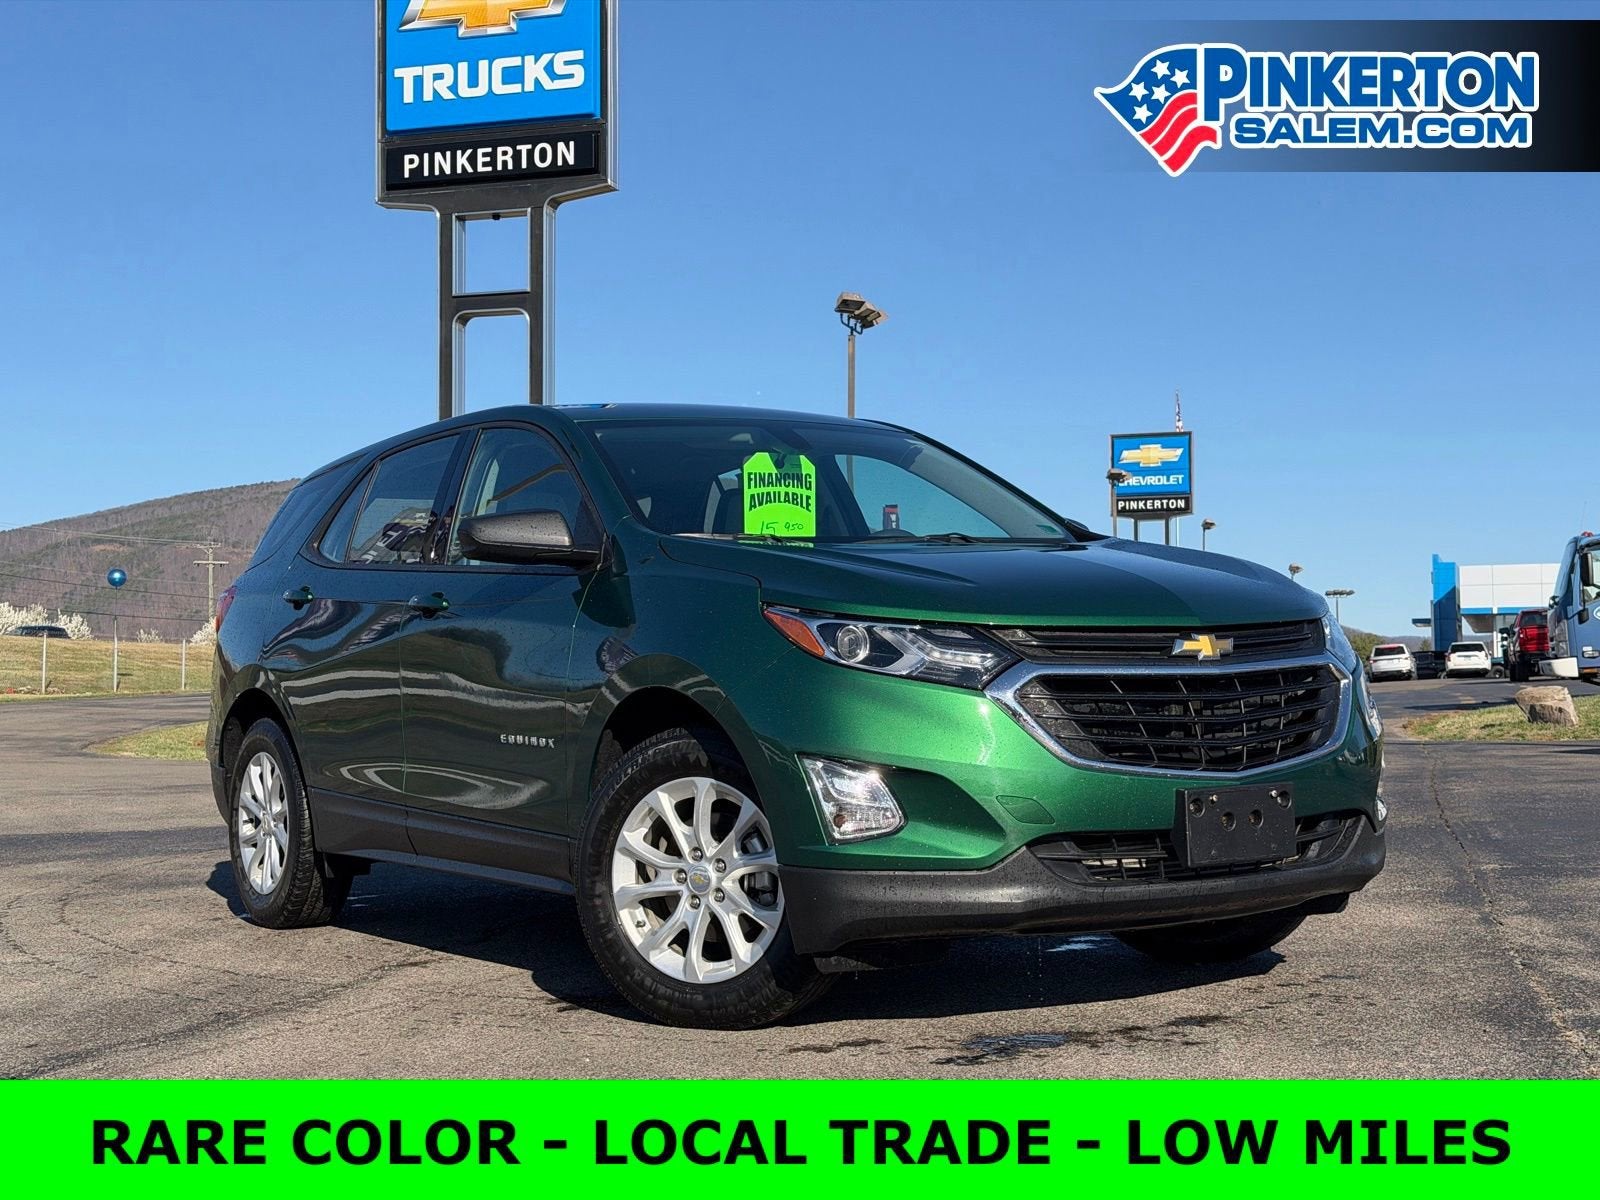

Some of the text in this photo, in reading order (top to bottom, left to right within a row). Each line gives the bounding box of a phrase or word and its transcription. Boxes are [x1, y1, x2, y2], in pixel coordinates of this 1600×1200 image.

[394, 50, 585, 104] TRUCKS
[403, 141, 575, 178] PINKERTON
[747, 472, 812, 491] FINANCING
[748, 491, 812, 512] AVAILABLE
[1118, 500, 1185, 510] PINKERTON
[760, 521, 804, 535] 15 950
[500, 734, 555, 749] EQUINOX
